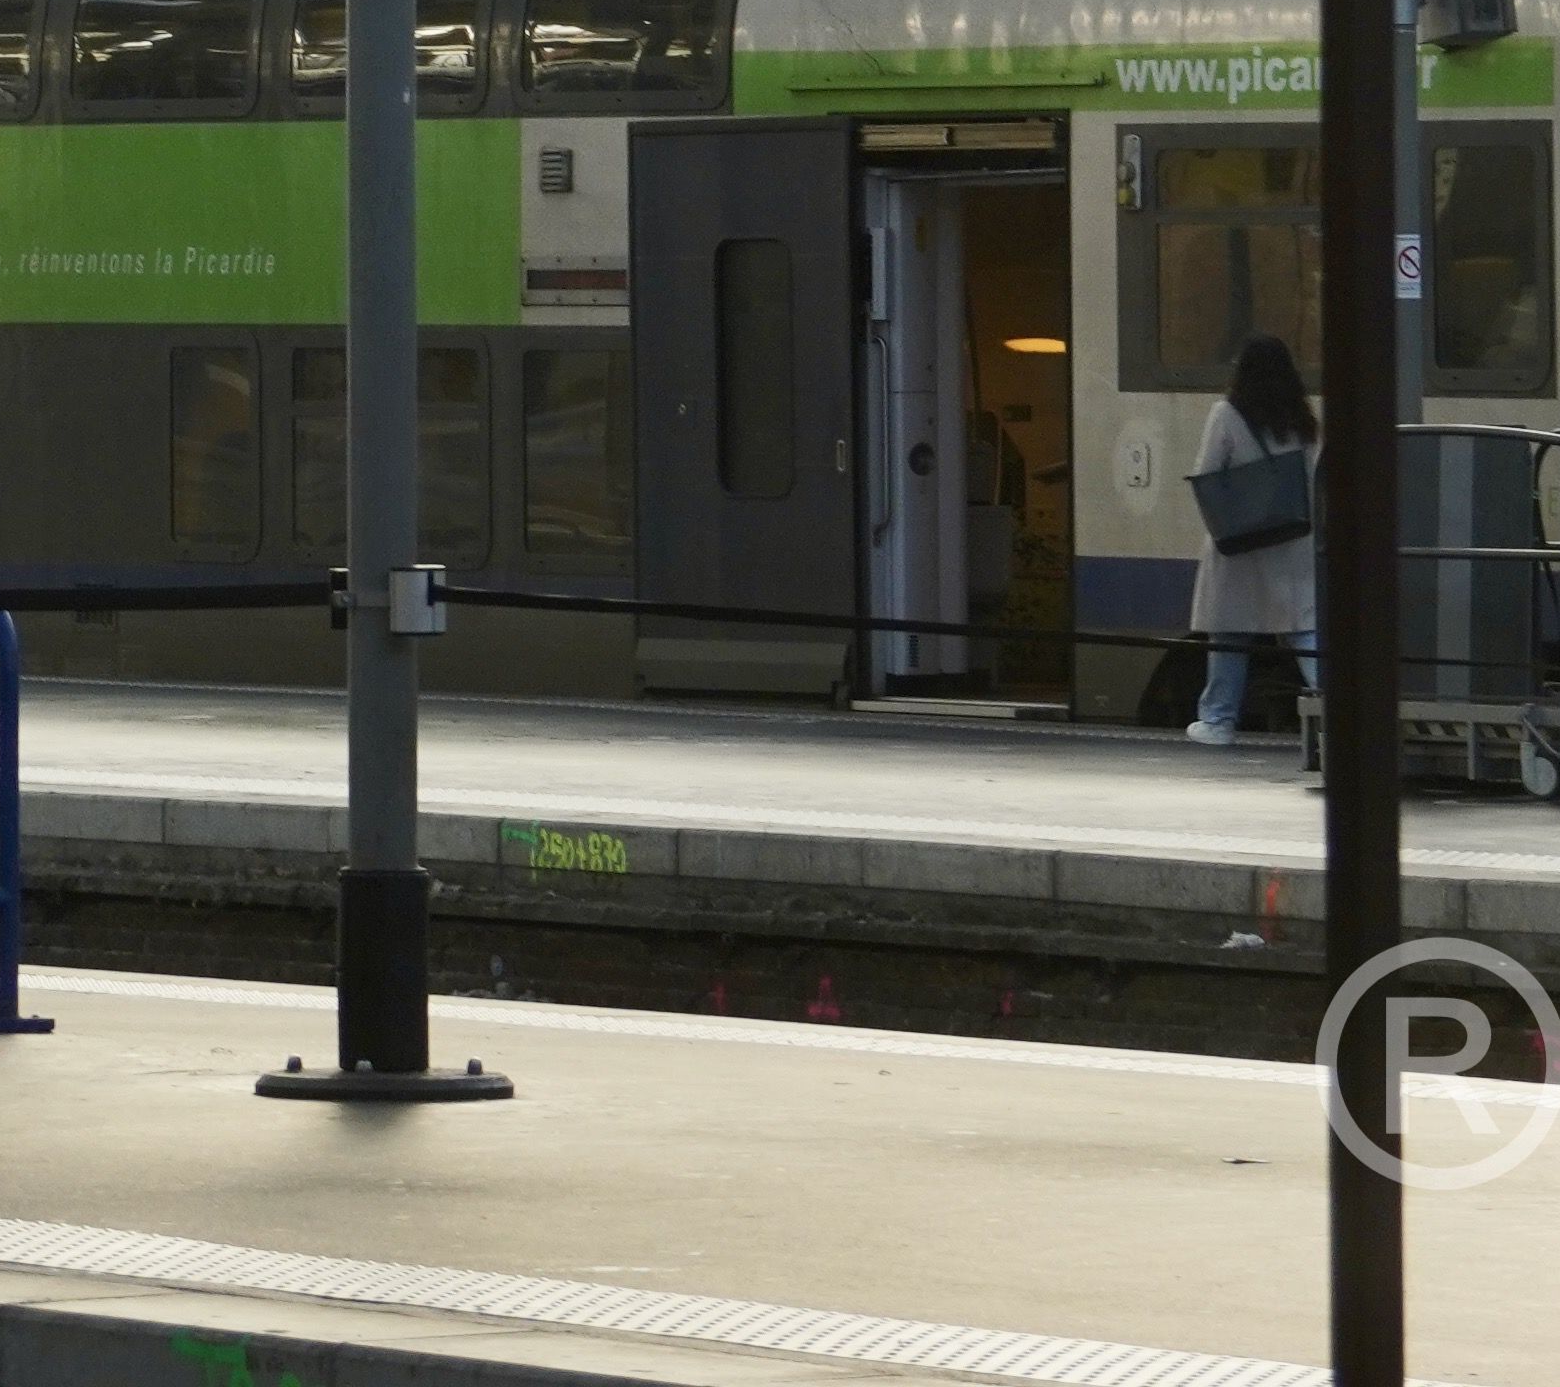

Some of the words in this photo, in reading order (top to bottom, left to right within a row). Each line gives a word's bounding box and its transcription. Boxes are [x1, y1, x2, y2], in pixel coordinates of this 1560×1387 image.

[20, 246, 145, 275] réinventons
[155, 248, 173, 275] la
[184, 246, 277, 275] Picardie
